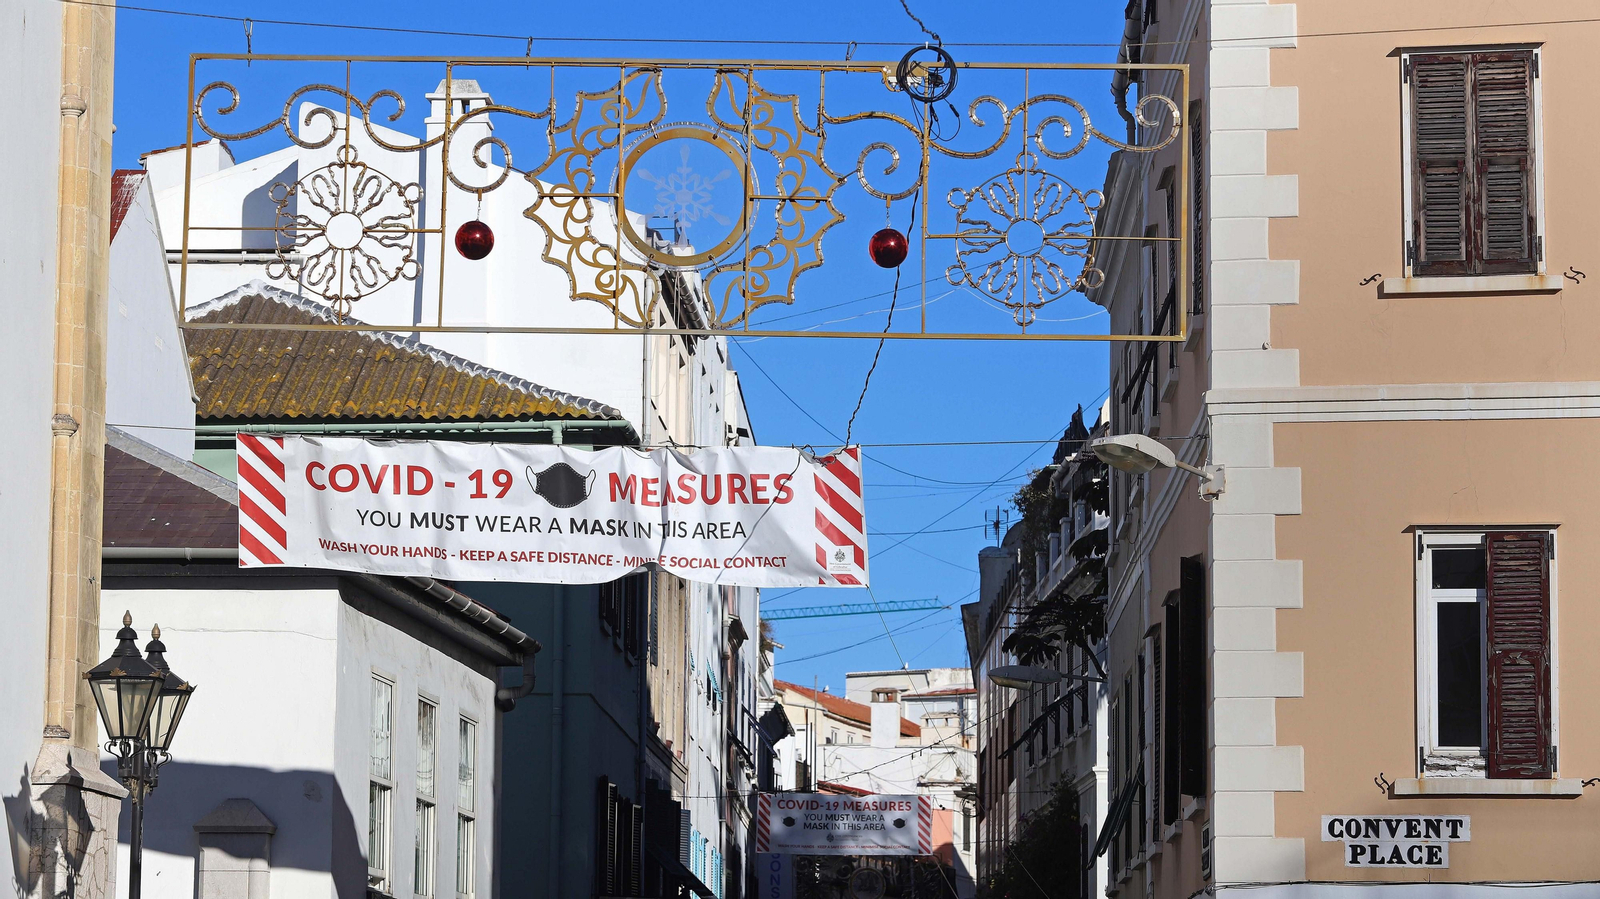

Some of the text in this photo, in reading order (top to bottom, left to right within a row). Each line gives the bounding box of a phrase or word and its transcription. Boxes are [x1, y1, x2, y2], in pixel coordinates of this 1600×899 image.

[305, 461, 433, 496] COVID
[468, 469, 513, 499] 19
[609, 472, 794, 507] MEASURES
[356, 509, 401, 528] YOU
[410, 512, 469, 532] MUST
[475, 515, 542, 533] WEAR
[548, 517, 563, 534] A
[570, 518, 629, 538] MASK
[633, 521, 651, 539] IN
[692, 521, 747, 539] AREA
[318, 538, 358, 554] WASH
[360, 543, 399, 557] YOUR
[402, 546, 447, 560] HANDS
[460, 550, 495, 562] KEEP
[497, 551, 508, 562] A
[510, 551, 544, 563] SAFE
[547, 551, 613, 566] DISTANCE
[669, 556, 721, 569] SOCIAL
[723, 556, 787, 569] CONTACT
[777, 799, 912, 811] COVID-19 MEASURES
[803, 822, 829, 830] MASK
[804, 813, 823, 821] YOU
[825, 813, 850, 821] MUST
[852, 814, 877, 822] WEAR
[1328, 818, 1463, 838] CONVENT
[1349, 844, 1443, 865] PLACE
